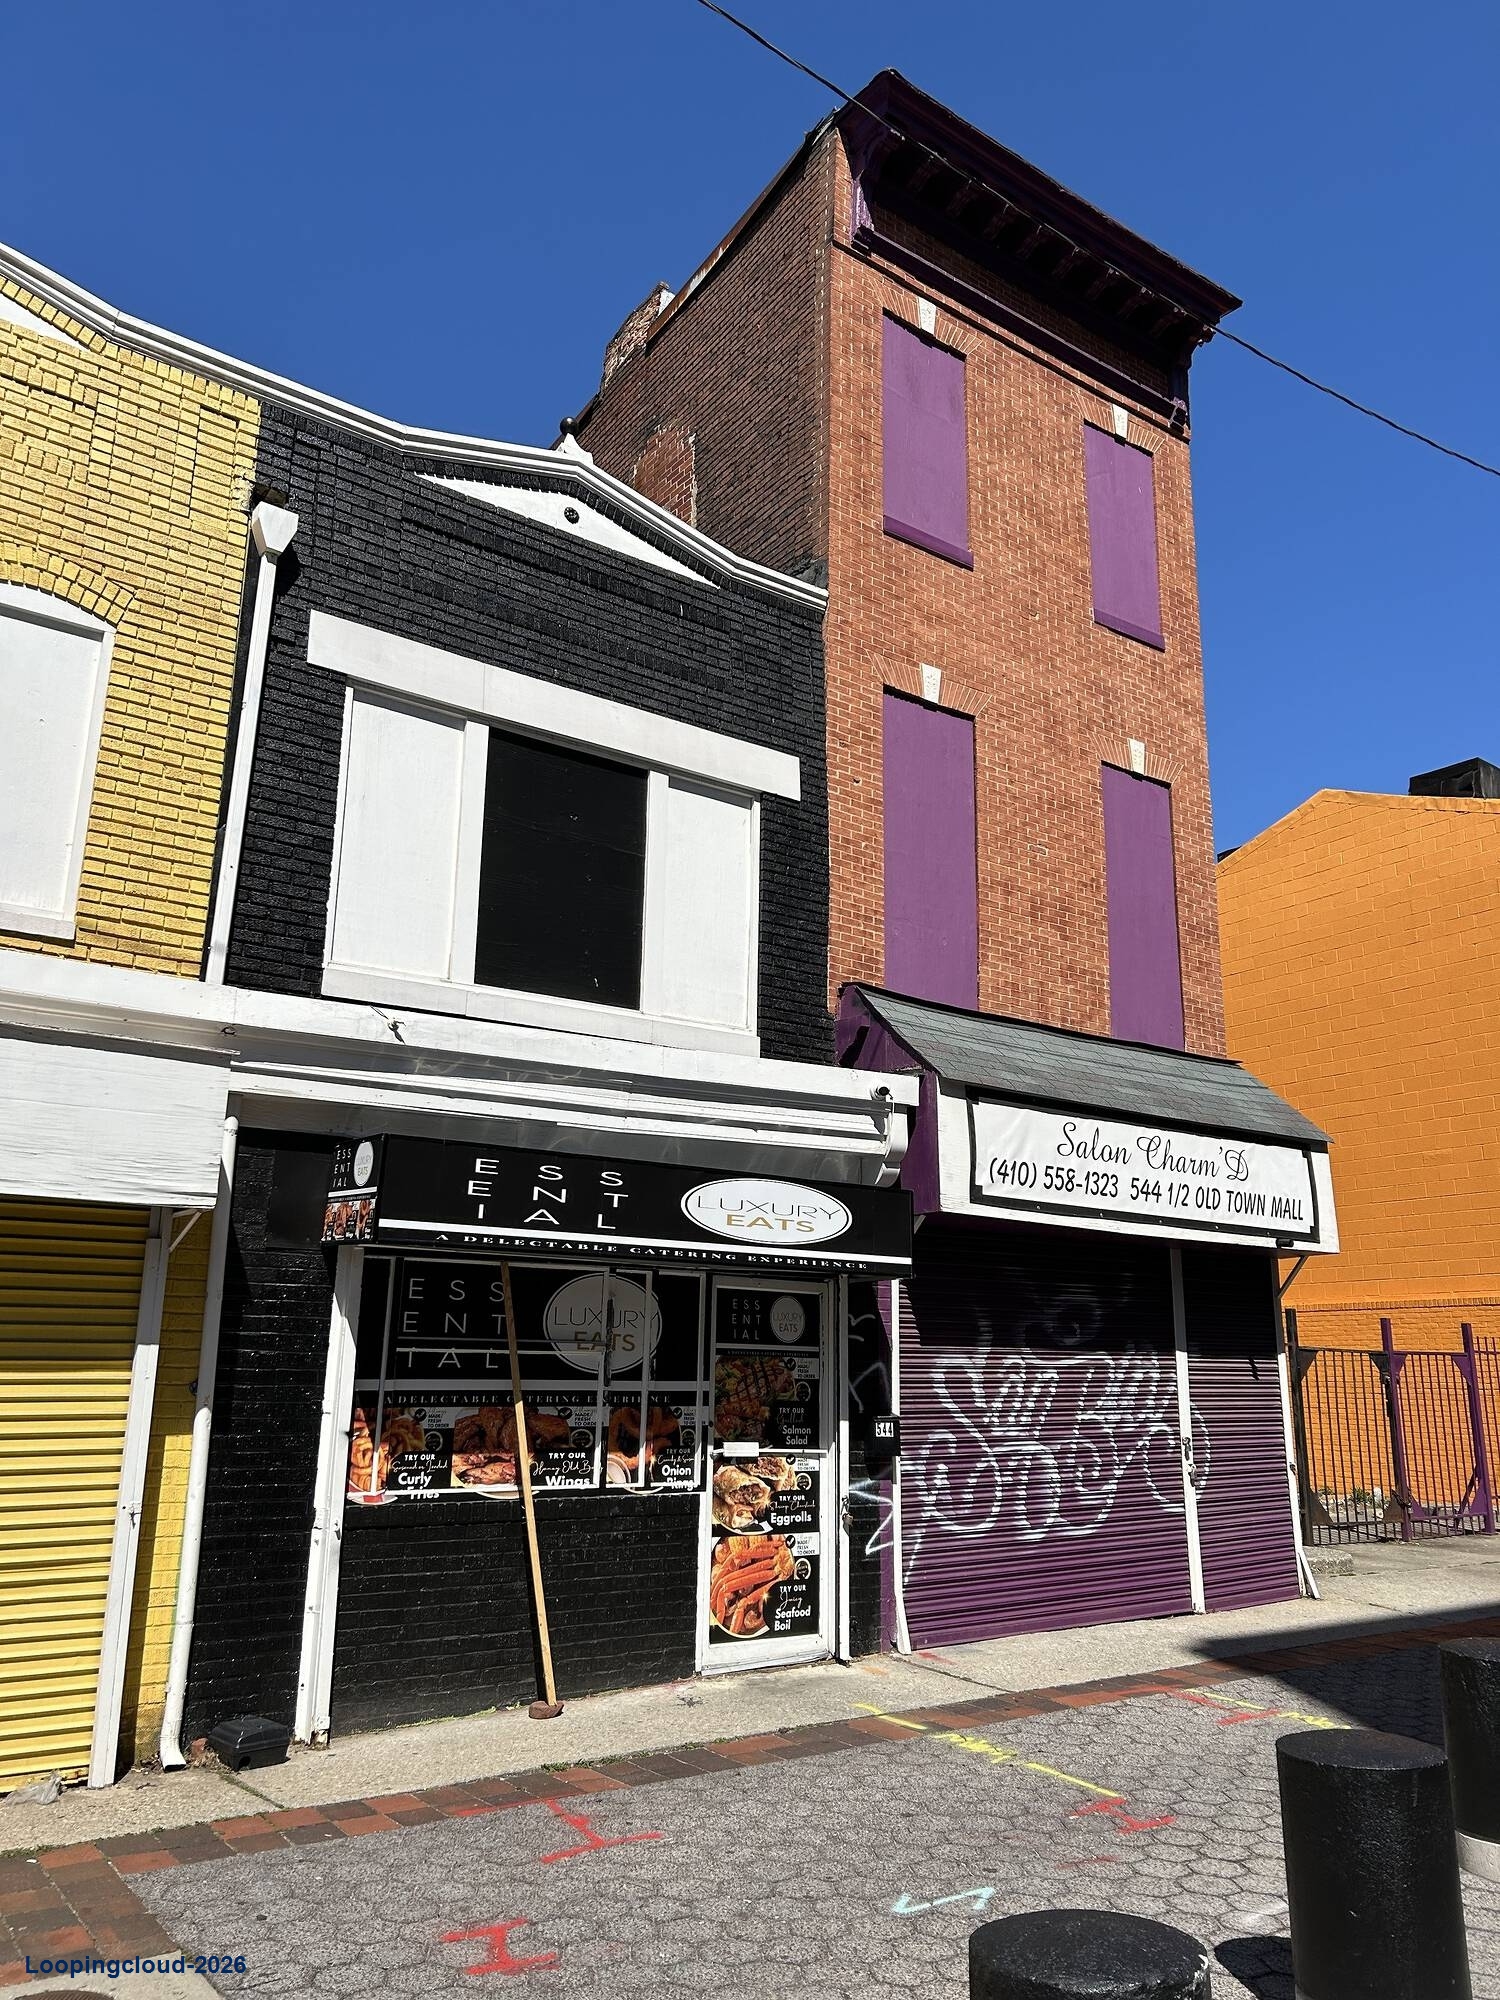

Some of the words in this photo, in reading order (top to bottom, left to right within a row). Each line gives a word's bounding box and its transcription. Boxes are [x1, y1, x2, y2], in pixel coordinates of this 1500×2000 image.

[1056, 1121, 1132, 1165] Salon
[989, 1157, 1038, 1189] (410)
[1043, 1165, 1119, 1198] 558-1323
[1130, 1177, 1163, 1203] 544
[1168, 1181, 1189, 1209] 1/2
[1196, 1186, 1221, 1211] OLD
[1226, 1190, 1266, 1217] TOWN
[1271, 1196, 1304, 1221] MALL
[697, 1194, 841, 1220] LUXURY
[726, 1214, 815, 1233] EATS
[463, 1235, 618, 1252] DELECTABLE
[629, 1246, 736, 1261] CATERING
[748, 1255, 868, 1269] EXPERIENCE
[778, 1323, 799, 1333] EATS
[398, 1395, 499, 1404] DELECTABLE
[506, 1395, 579, 1404] CTERING
[782, 1424, 811, 1435] Salmon
[876, 1422, 892, 1436] 544
[785, 1435, 808, 1445] Salad
[420, 1453, 436, 1461] OUR
[662, 1464, 692, 1476] Onion
[398, 1471, 433, 1487] Curly
[545, 1475, 591, 1490] Wings
[779, 1495, 790, 1503] TRY
[792, 1494, 806, 1502] OUR
[770, 1510, 812, 1527] Eggrolls
[780, 1585, 791, 1593] TRY
[793, 1584, 807, 1592] OUR
[774, 1604, 811, 1620] Seafood
[774, 1619, 791, 1631] Boil
